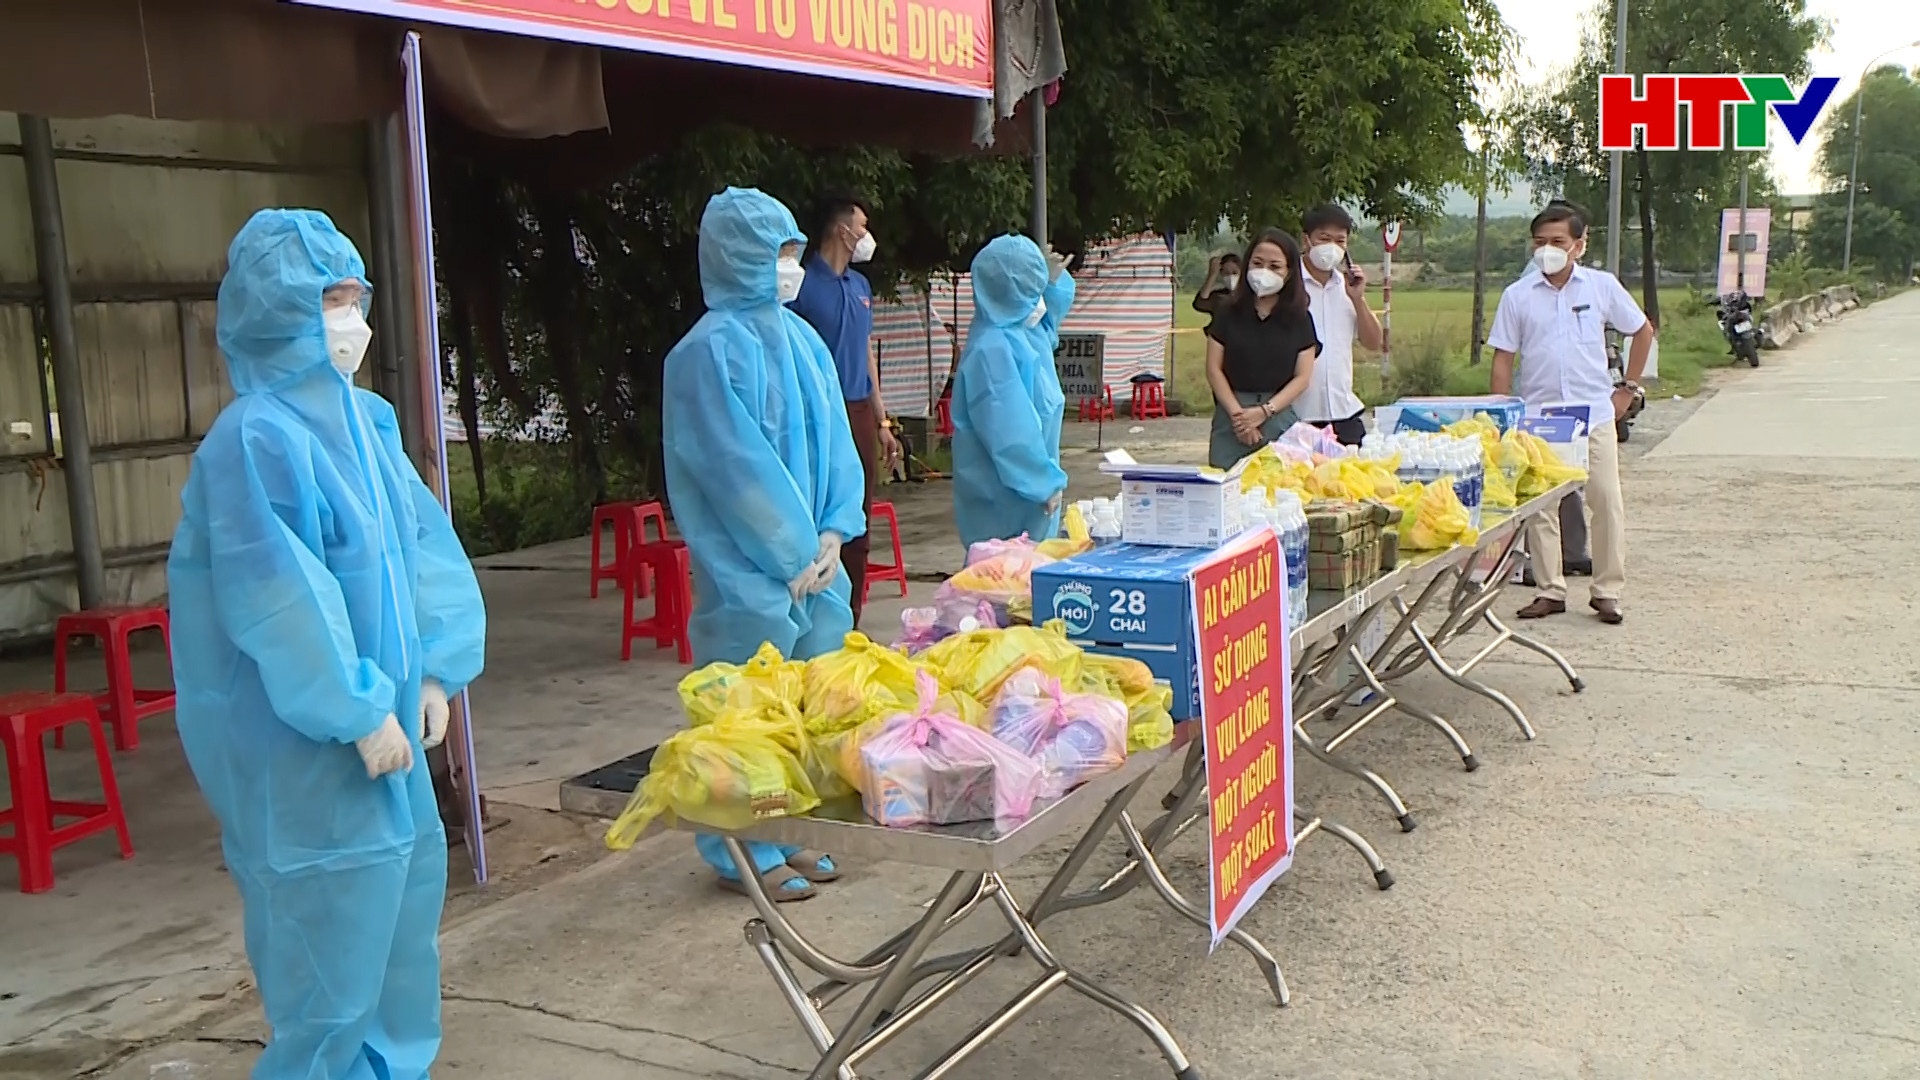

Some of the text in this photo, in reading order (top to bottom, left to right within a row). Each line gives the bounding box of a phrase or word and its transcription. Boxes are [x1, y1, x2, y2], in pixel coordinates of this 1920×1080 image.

[907, 1, 974, 75] DỊCH
[1109, 588, 1147, 616] 28
[1203, 584, 1218, 631] AI
[1249, 542, 1272, 601] LẤY
[1110, 618, 1147, 633] CHAI
[1213, 634, 1233, 695] SỬ
[1234, 622, 1268, 681] DỤNG
[1215, 686, 1270, 763] VUI LÒNG
[1214, 740, 1277, 837] MỘT NGƯỜI
[1220, 802, 1275, 901] MỘT SUẤT
